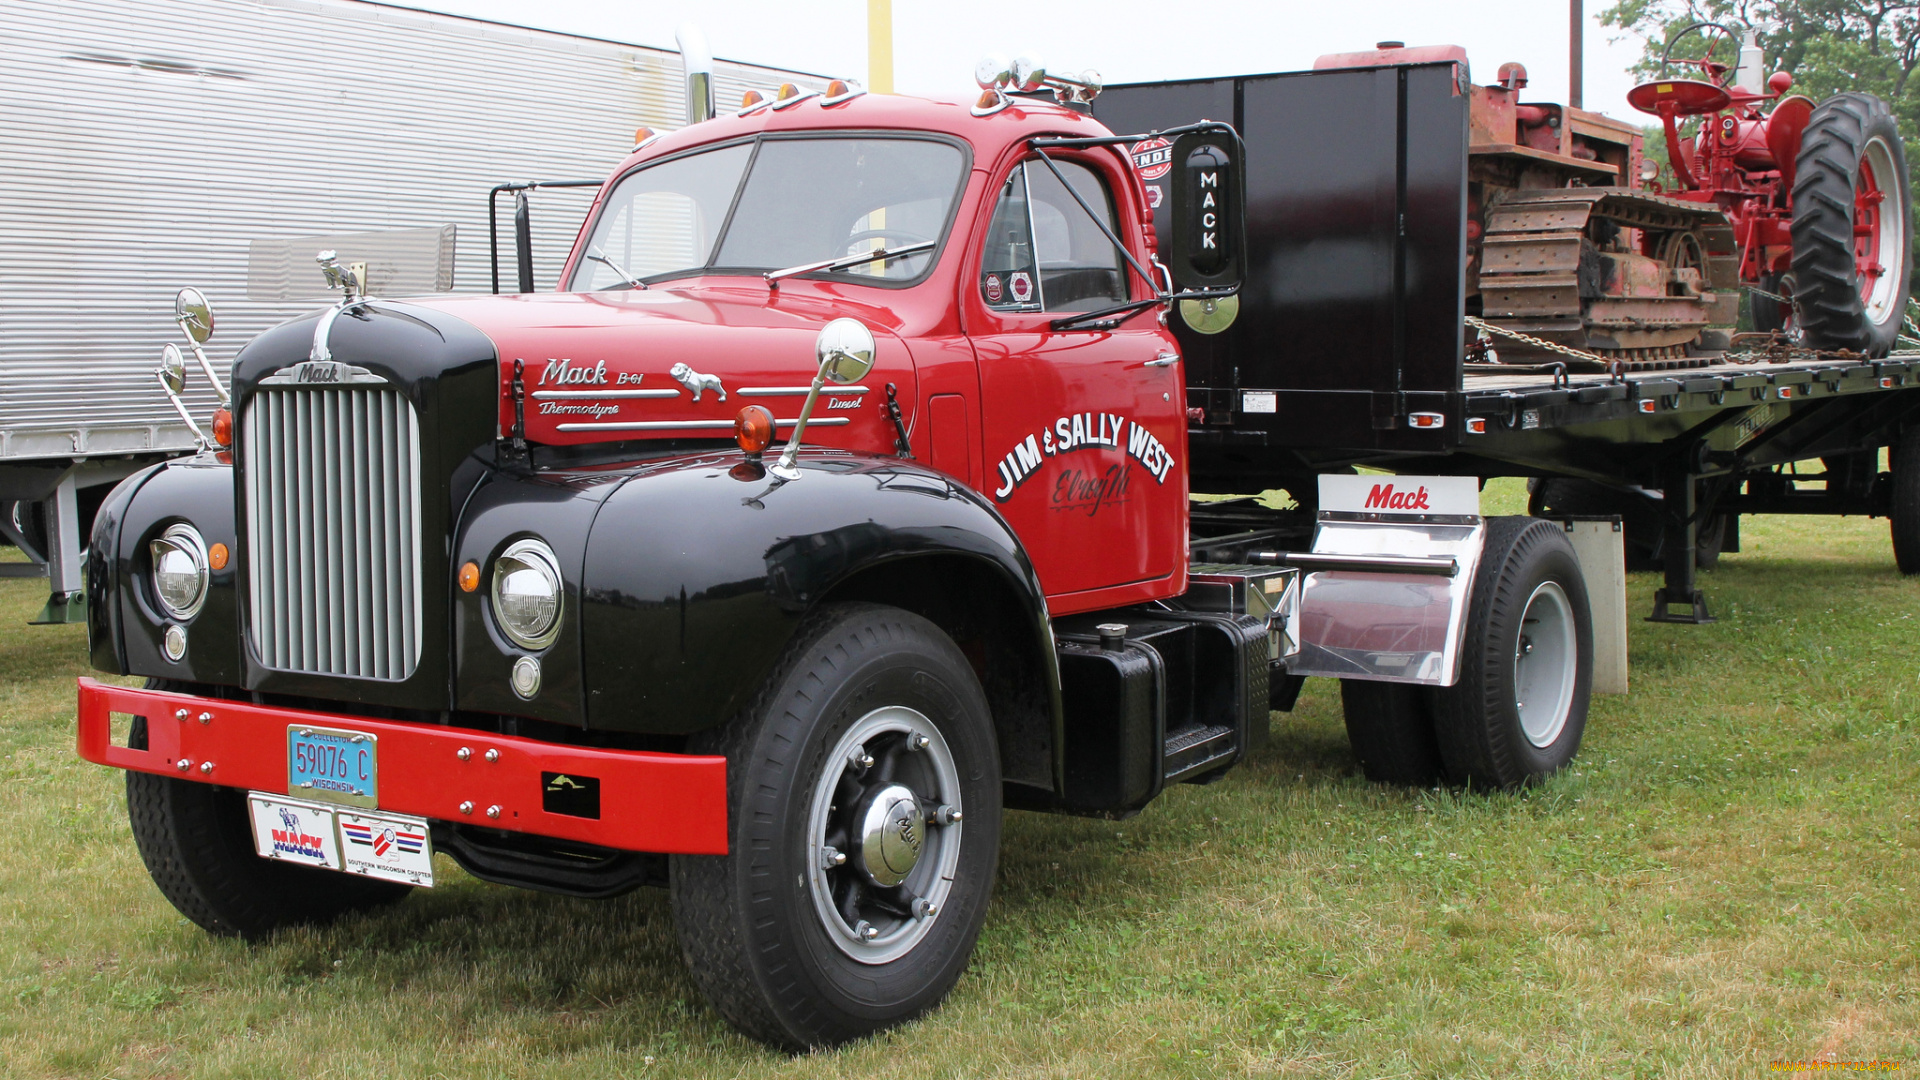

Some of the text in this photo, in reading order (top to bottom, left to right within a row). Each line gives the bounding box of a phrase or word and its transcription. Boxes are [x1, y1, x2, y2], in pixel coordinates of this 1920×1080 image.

[1133, 148, 1172, 166] ENDE
[1200, 171, 1217, 250] MACK
[298, 363, 339, 383] Mack
[538, 357, 645, 386] Mack B-61
[538, 400, 620, 421] Thermodyne
[827, 396, 863, 410] Diesel
[995, 411, 1176, 500] JIM & SALLY WEST
[1364, 483, 1431, 511] Mack
[296, 742, 369, 781] 59076 C
[311, 778, 355, 792] WISCONSIN
[271, 828, 326, 859] MACK
[347, 859, 433, 879] SOUTHERN WISCONSIN CHAPTER
